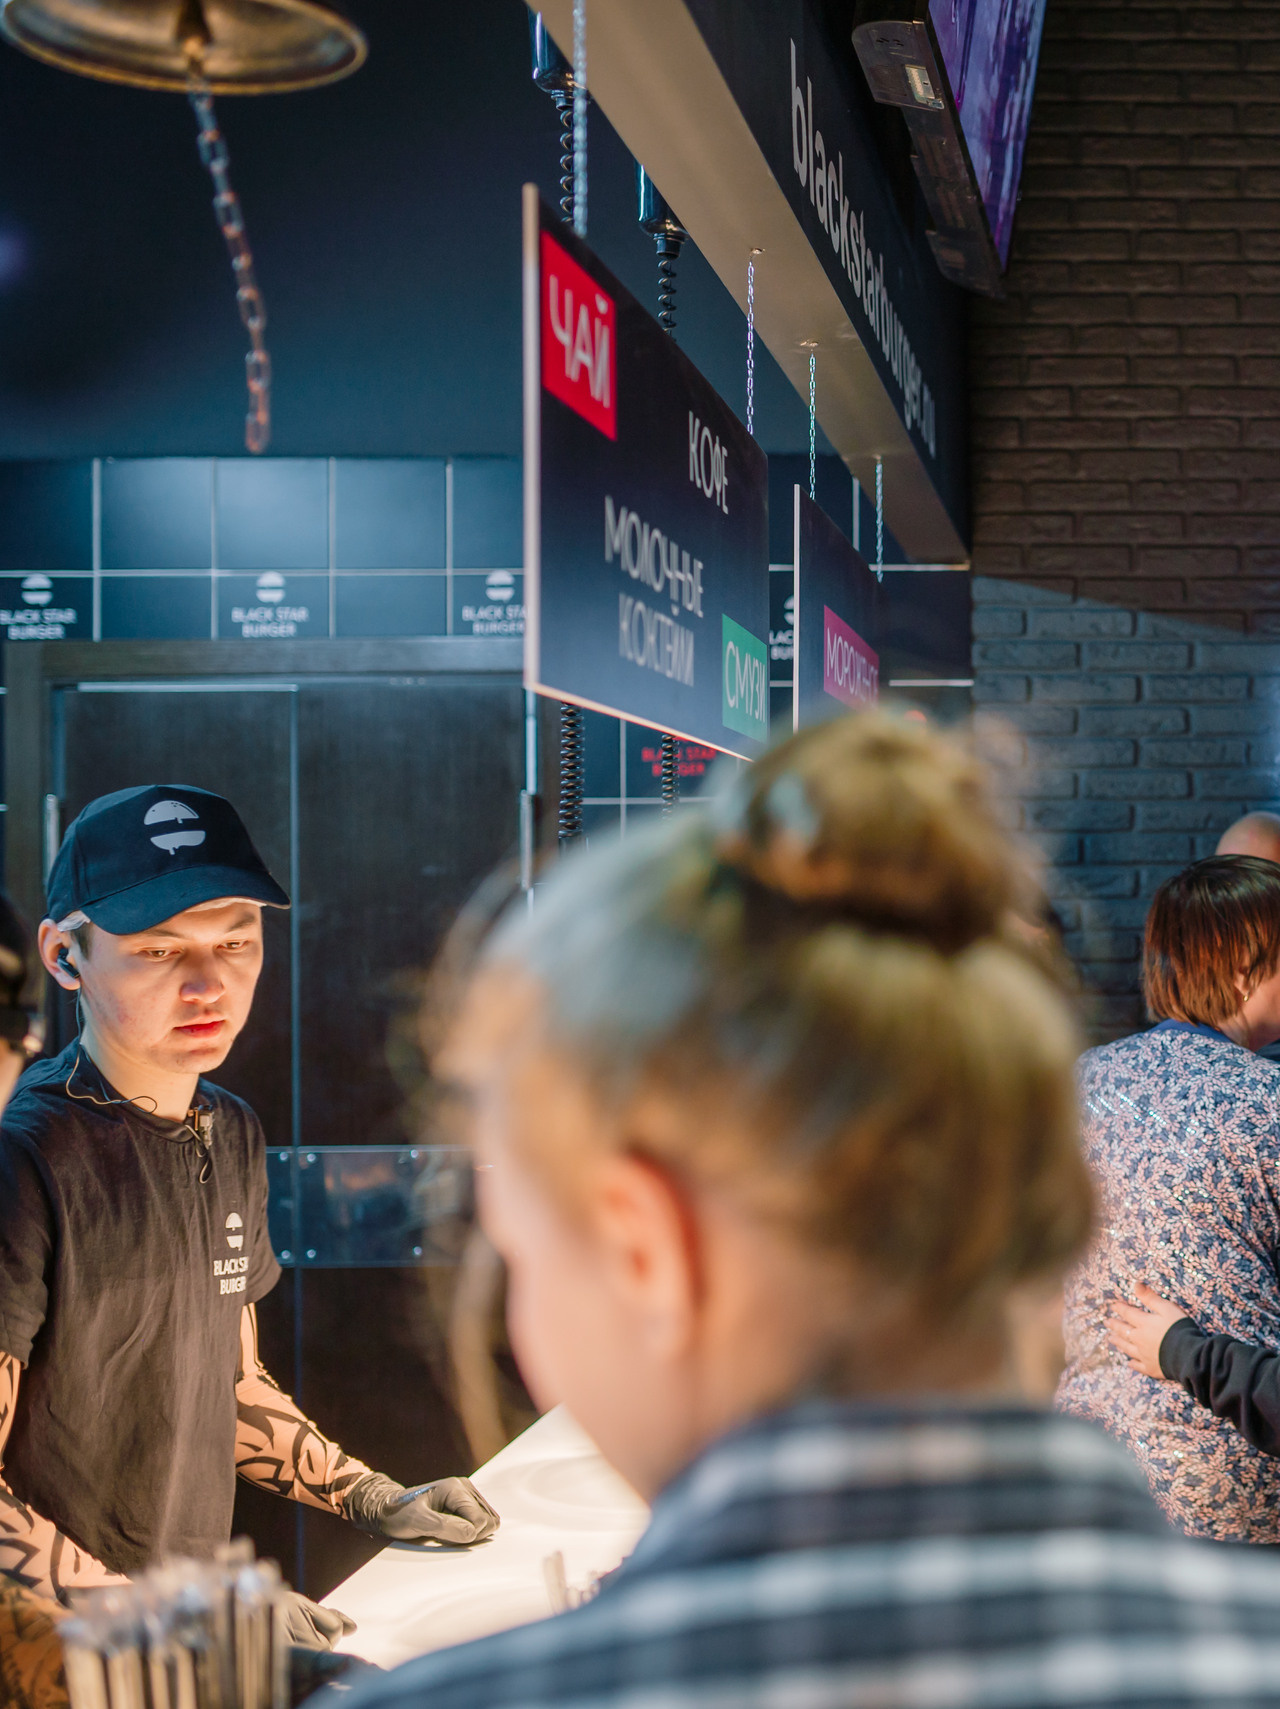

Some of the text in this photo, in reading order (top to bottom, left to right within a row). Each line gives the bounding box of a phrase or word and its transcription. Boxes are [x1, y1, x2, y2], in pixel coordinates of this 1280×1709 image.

[549, 274, 611, 408] ЧАЙ
[689, 410, 729, 514] КОФЕ
[604, 495, 704, 618] МОЛОЧНЫЕ
[42, 608, 76, 623] STAR
[231, 606, 309, 622] BLACK STAR
[462, 605, 504, 621] BLACK
[725, 640, 766, 723] СМУЗИ
[213, 1259, 239, 1276] BLACK
